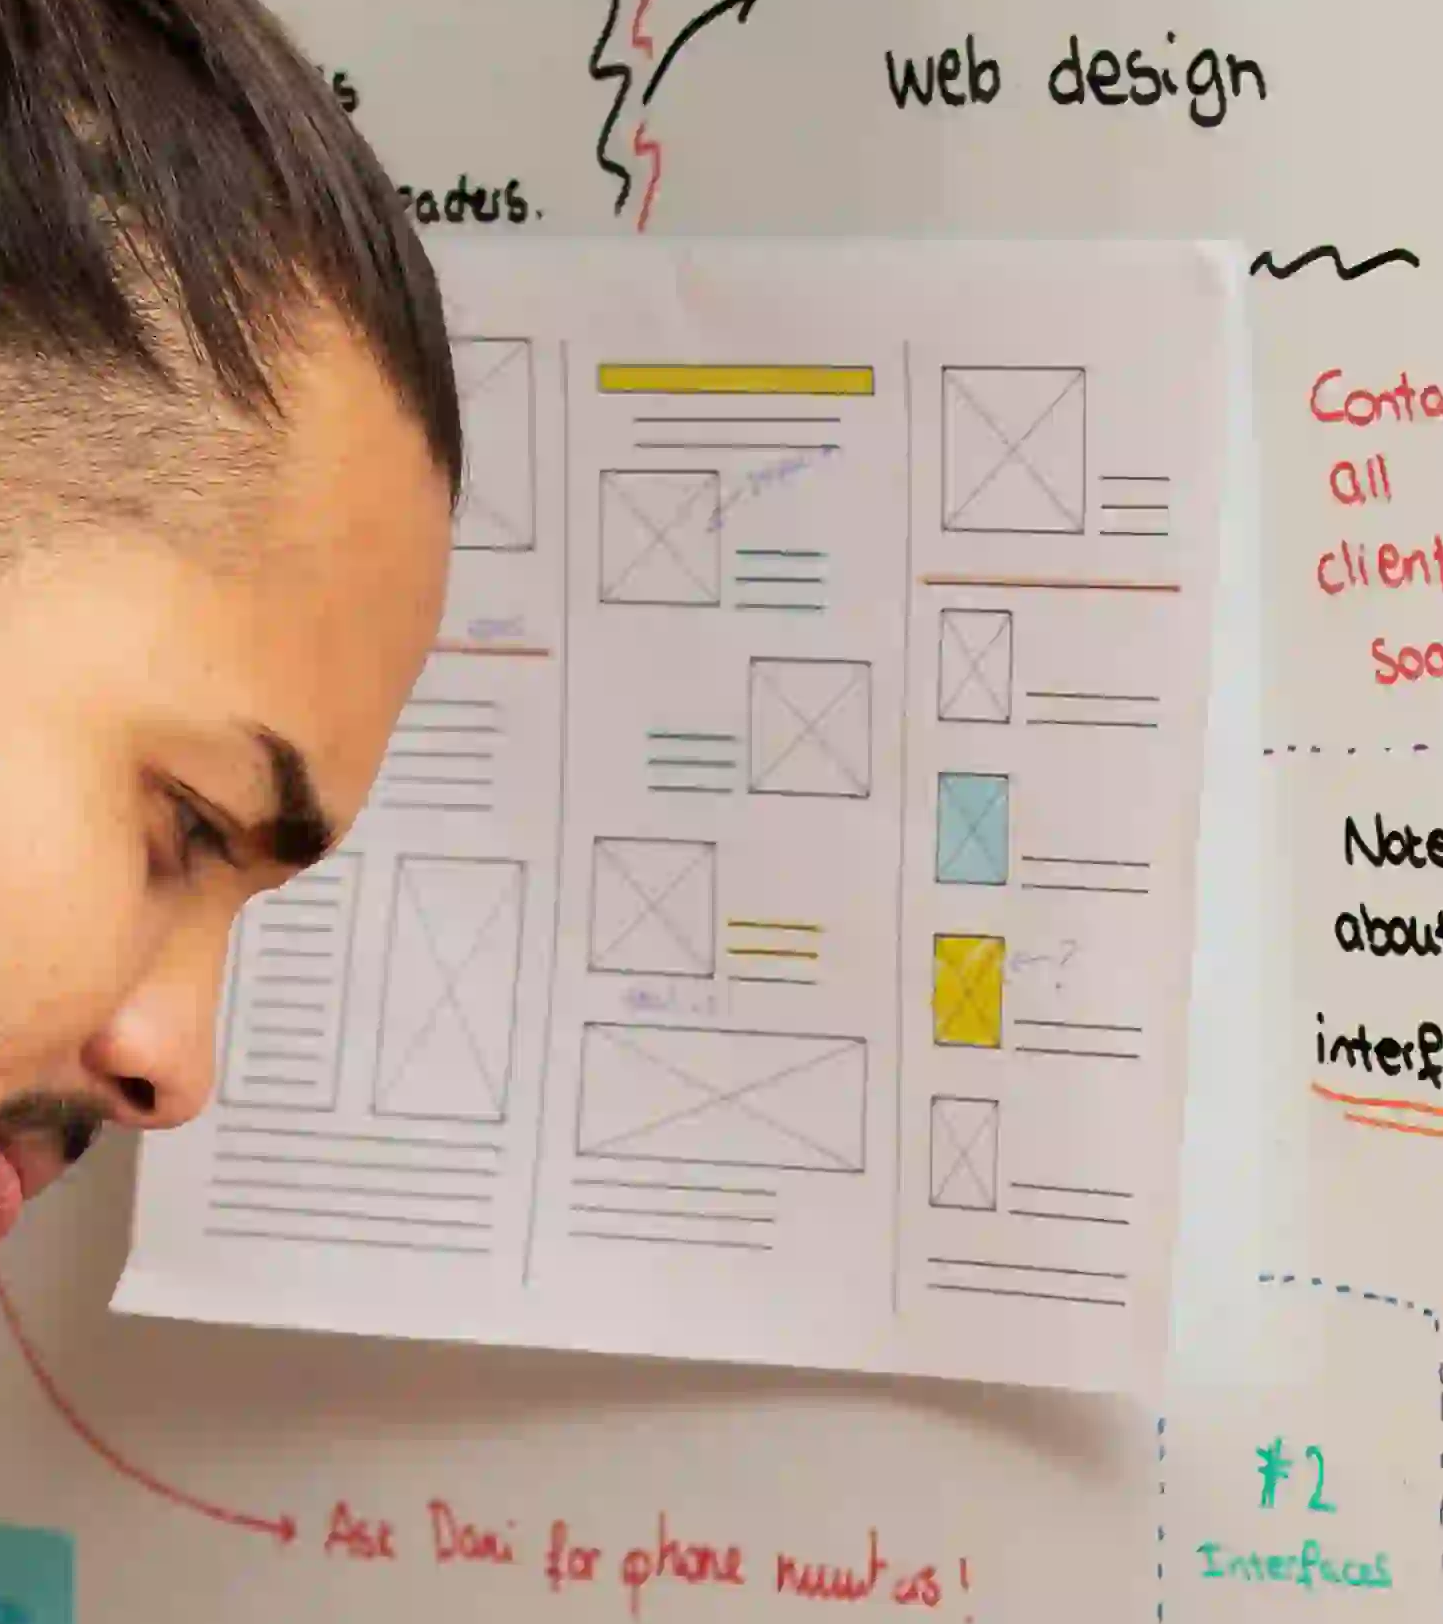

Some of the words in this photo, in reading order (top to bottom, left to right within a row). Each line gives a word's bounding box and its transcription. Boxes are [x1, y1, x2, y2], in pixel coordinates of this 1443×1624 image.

[884, 33, 1002, 111] web
[1048, 32, 1266, 127] design
[1330, 454, 1391, 505] all
[1256, 1438, 1336, 1513] #2
[545, 1520, 601, 1591] for
[620, 1510, 745, 1620] phone
